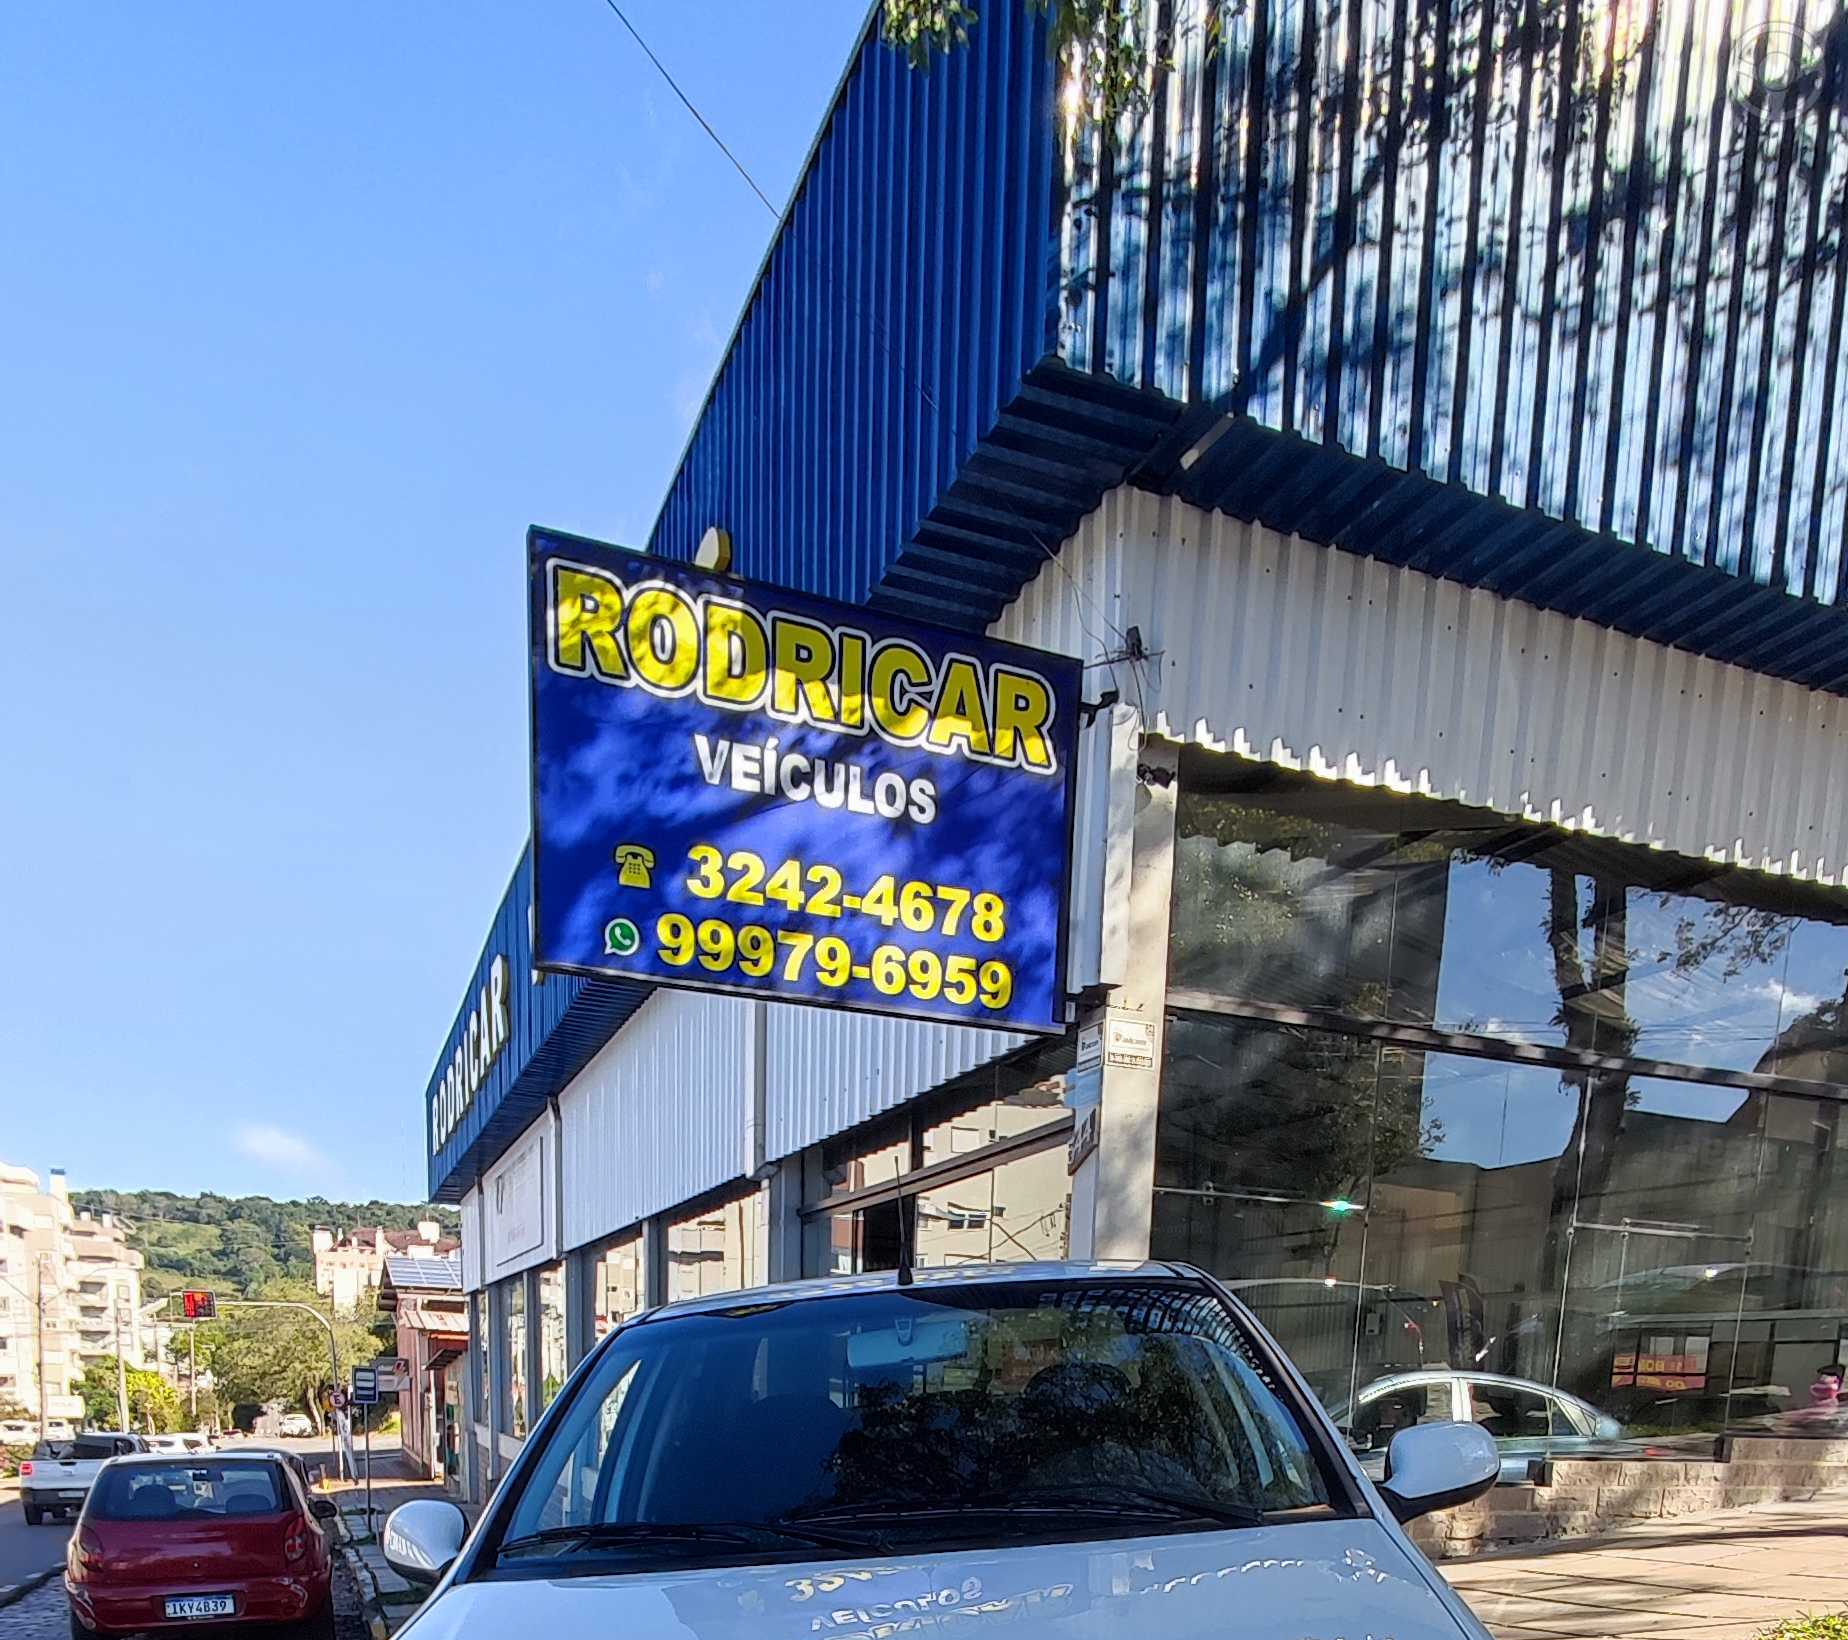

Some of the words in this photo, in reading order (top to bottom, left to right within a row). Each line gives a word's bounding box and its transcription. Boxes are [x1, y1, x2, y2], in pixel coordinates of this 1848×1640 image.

[547, 557, 1057, 775] RODRICAR
[694, 734, 937, 824] VEÍCULOS
[686, 845, 1005, 943] 3242-4678
[656, 913, 1013, 1009] 99979-6959
[432, 954, 509, 1156] RODRICAR
